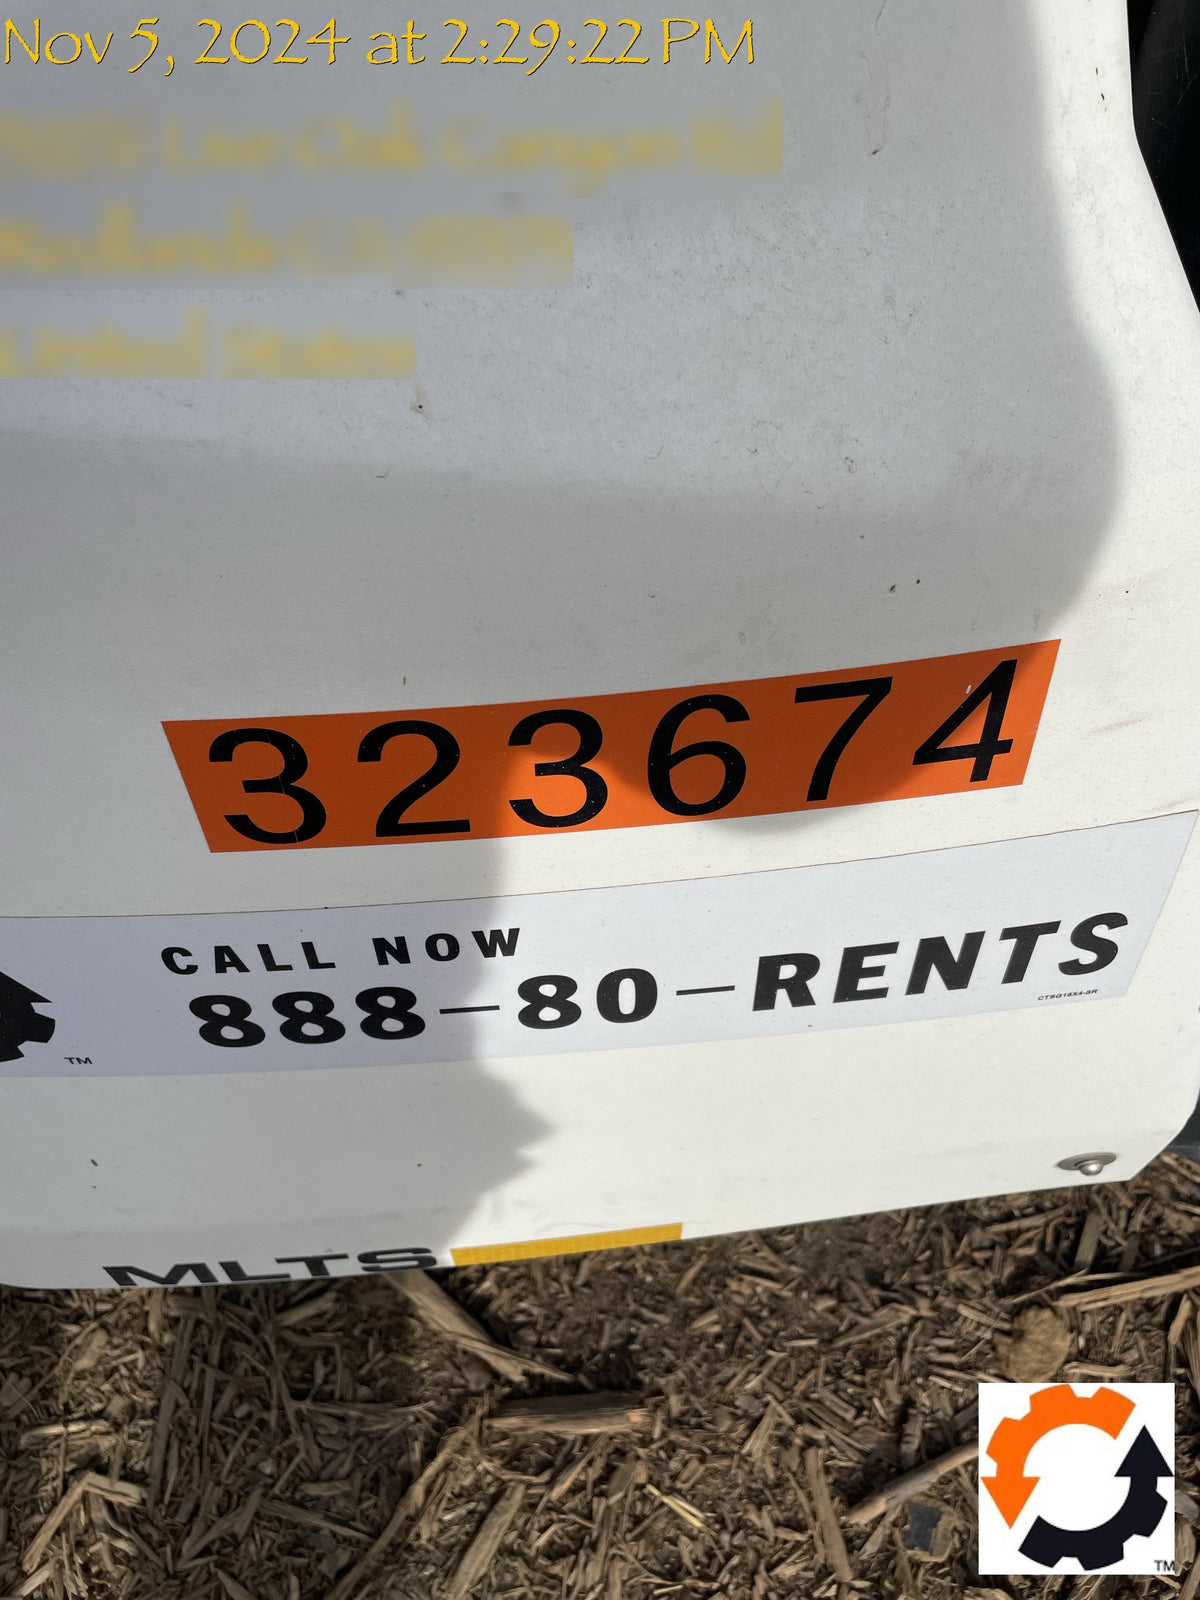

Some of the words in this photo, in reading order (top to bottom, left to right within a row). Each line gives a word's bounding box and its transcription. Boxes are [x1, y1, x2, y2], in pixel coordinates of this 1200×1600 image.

[207, 658, 1019, 847] 323674
[160, 941, 337, 976] CALL
[371, 927, 521, 966] NOW
[63, 1056, 93, 1065] TM
[102, 1247, 438, 1287] MLTS
